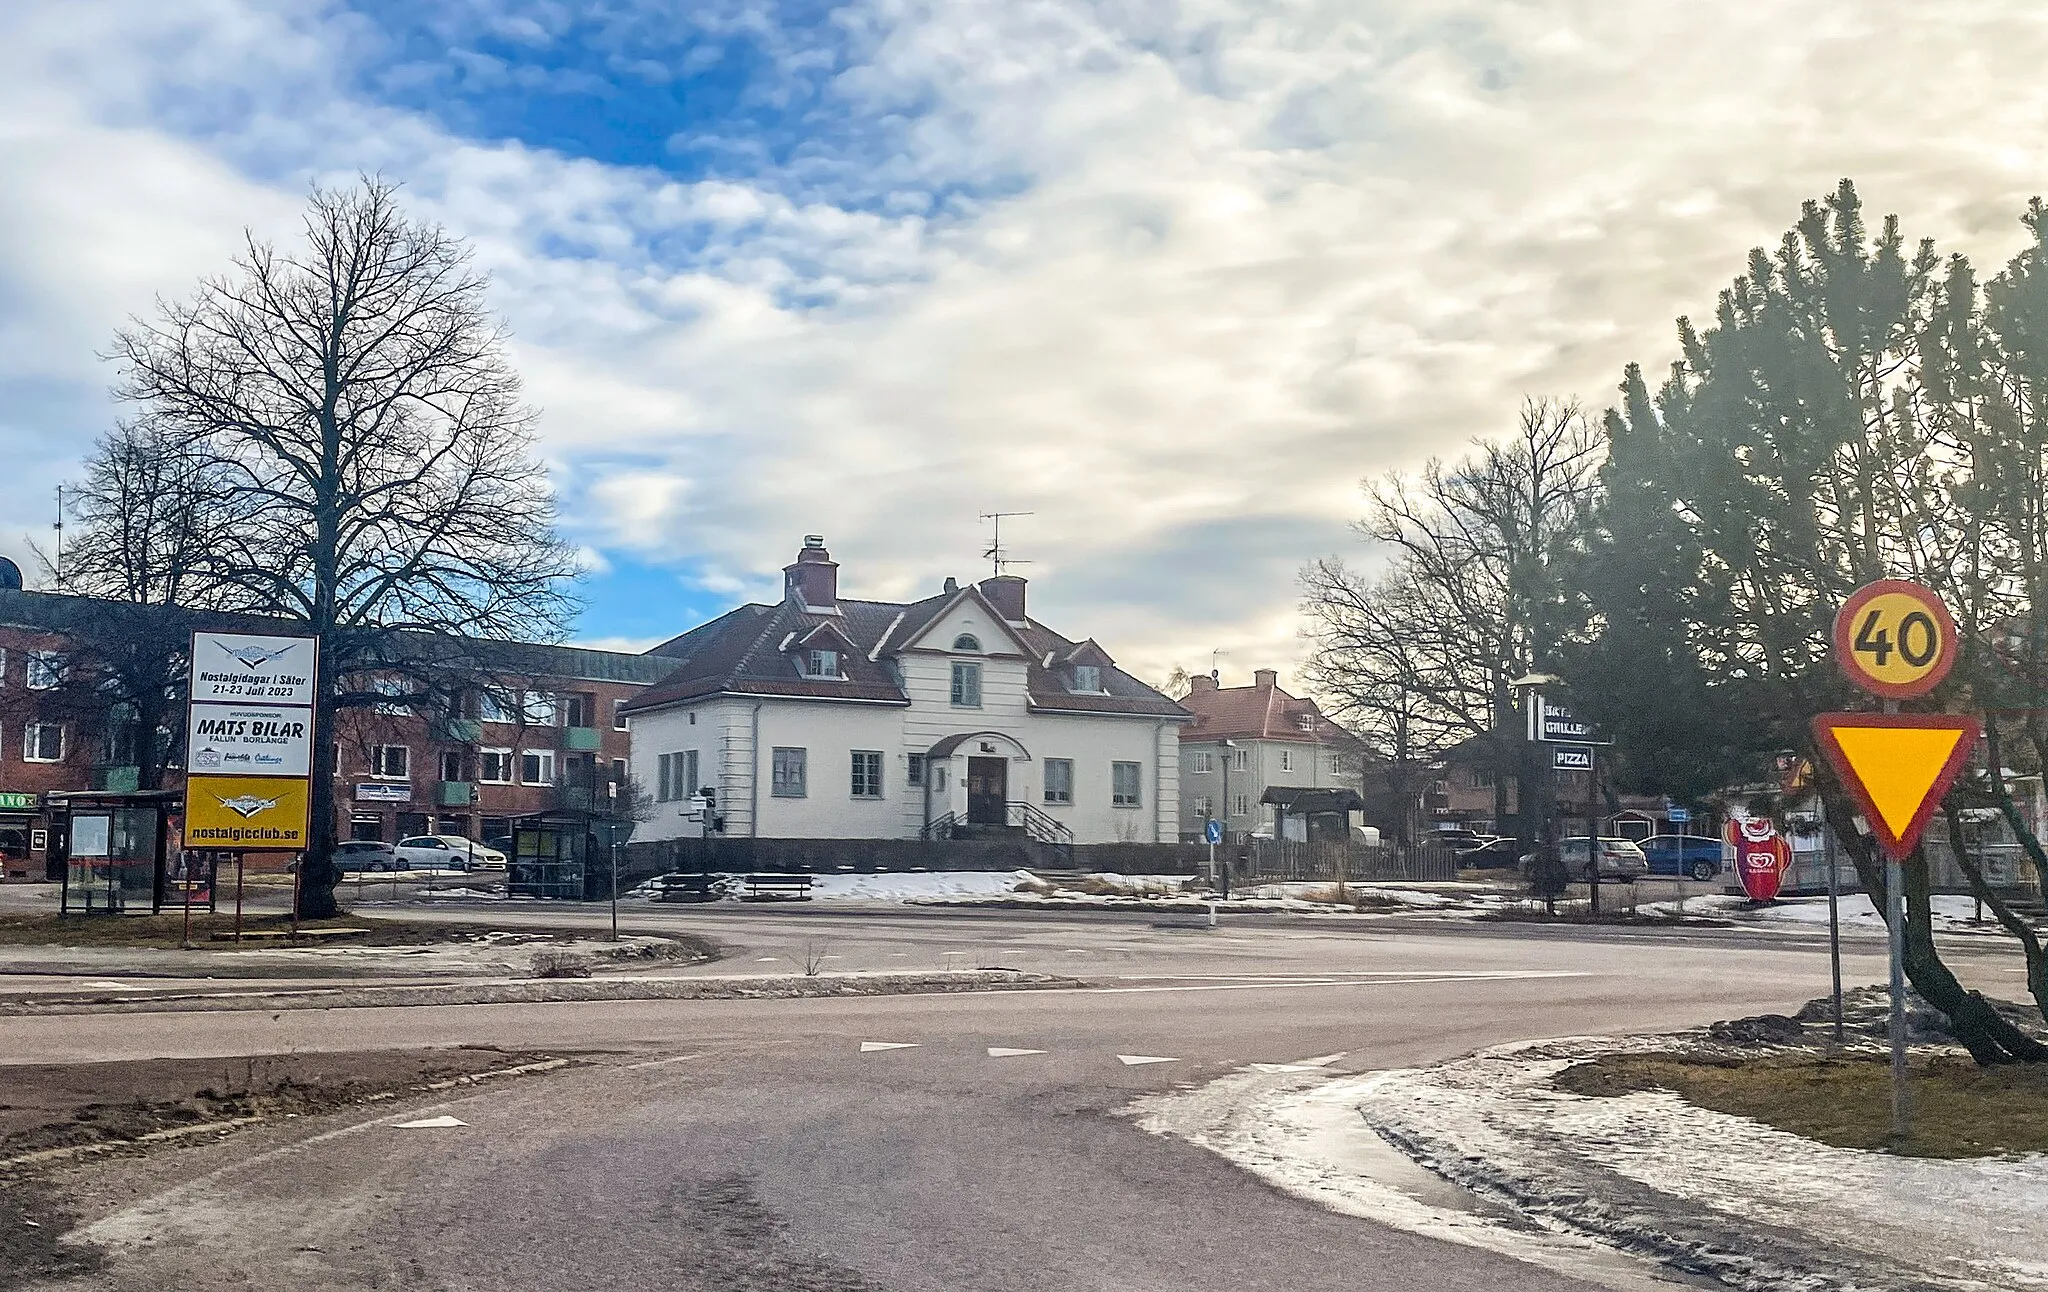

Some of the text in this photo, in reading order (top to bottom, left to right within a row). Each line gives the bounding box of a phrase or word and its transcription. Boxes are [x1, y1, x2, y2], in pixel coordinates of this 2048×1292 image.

[1854, 610, 1937, 667] 40
[200, 671, 271, 685] Nostalgidagar
[279, 675, 307, 686] Säter
[212, 684, 294, 697] 21-23 Juli 2023
[196, 719, 305, 738] MATS BILAR
[1556, 752, 1589, 765] PIZZA
[192, 827, 299, 842] nostalgicclub.se
